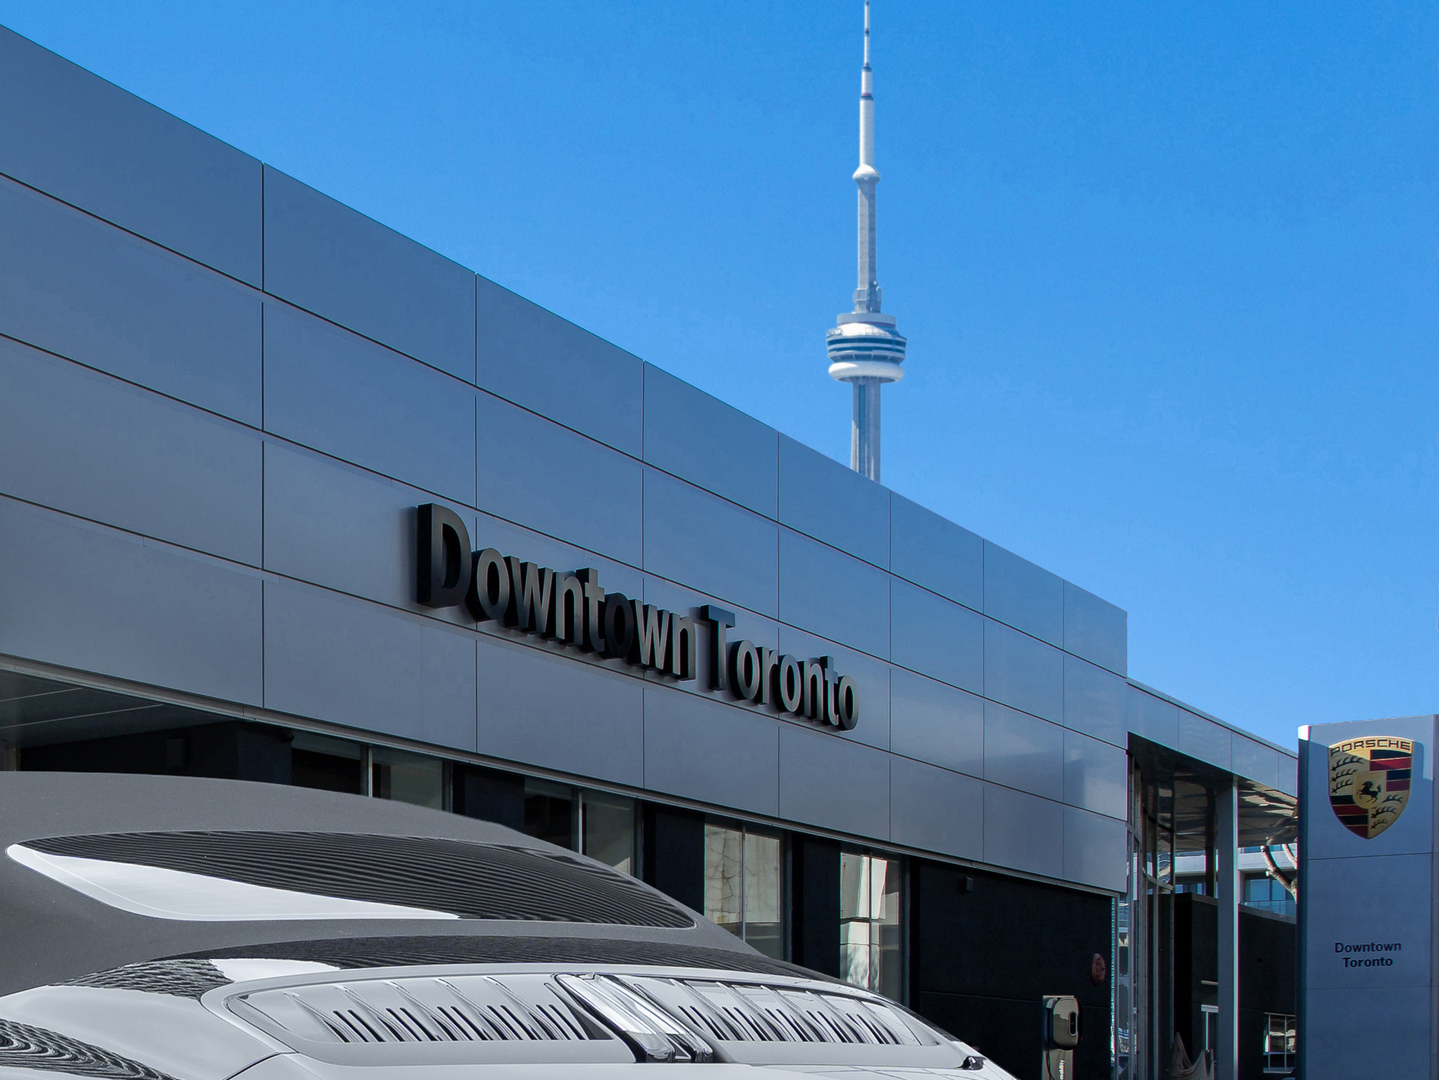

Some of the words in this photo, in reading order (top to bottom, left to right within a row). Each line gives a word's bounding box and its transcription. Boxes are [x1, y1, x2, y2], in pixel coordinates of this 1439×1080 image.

[416, 502, 696, 681] Downtown
[700, 604, 860, 731] Toronto
[1330, 738, 1411, 757] PORSCHE
[1334, 942, 1402, 954] Downtown
[1342, 957, 1393, 968] Toronto
